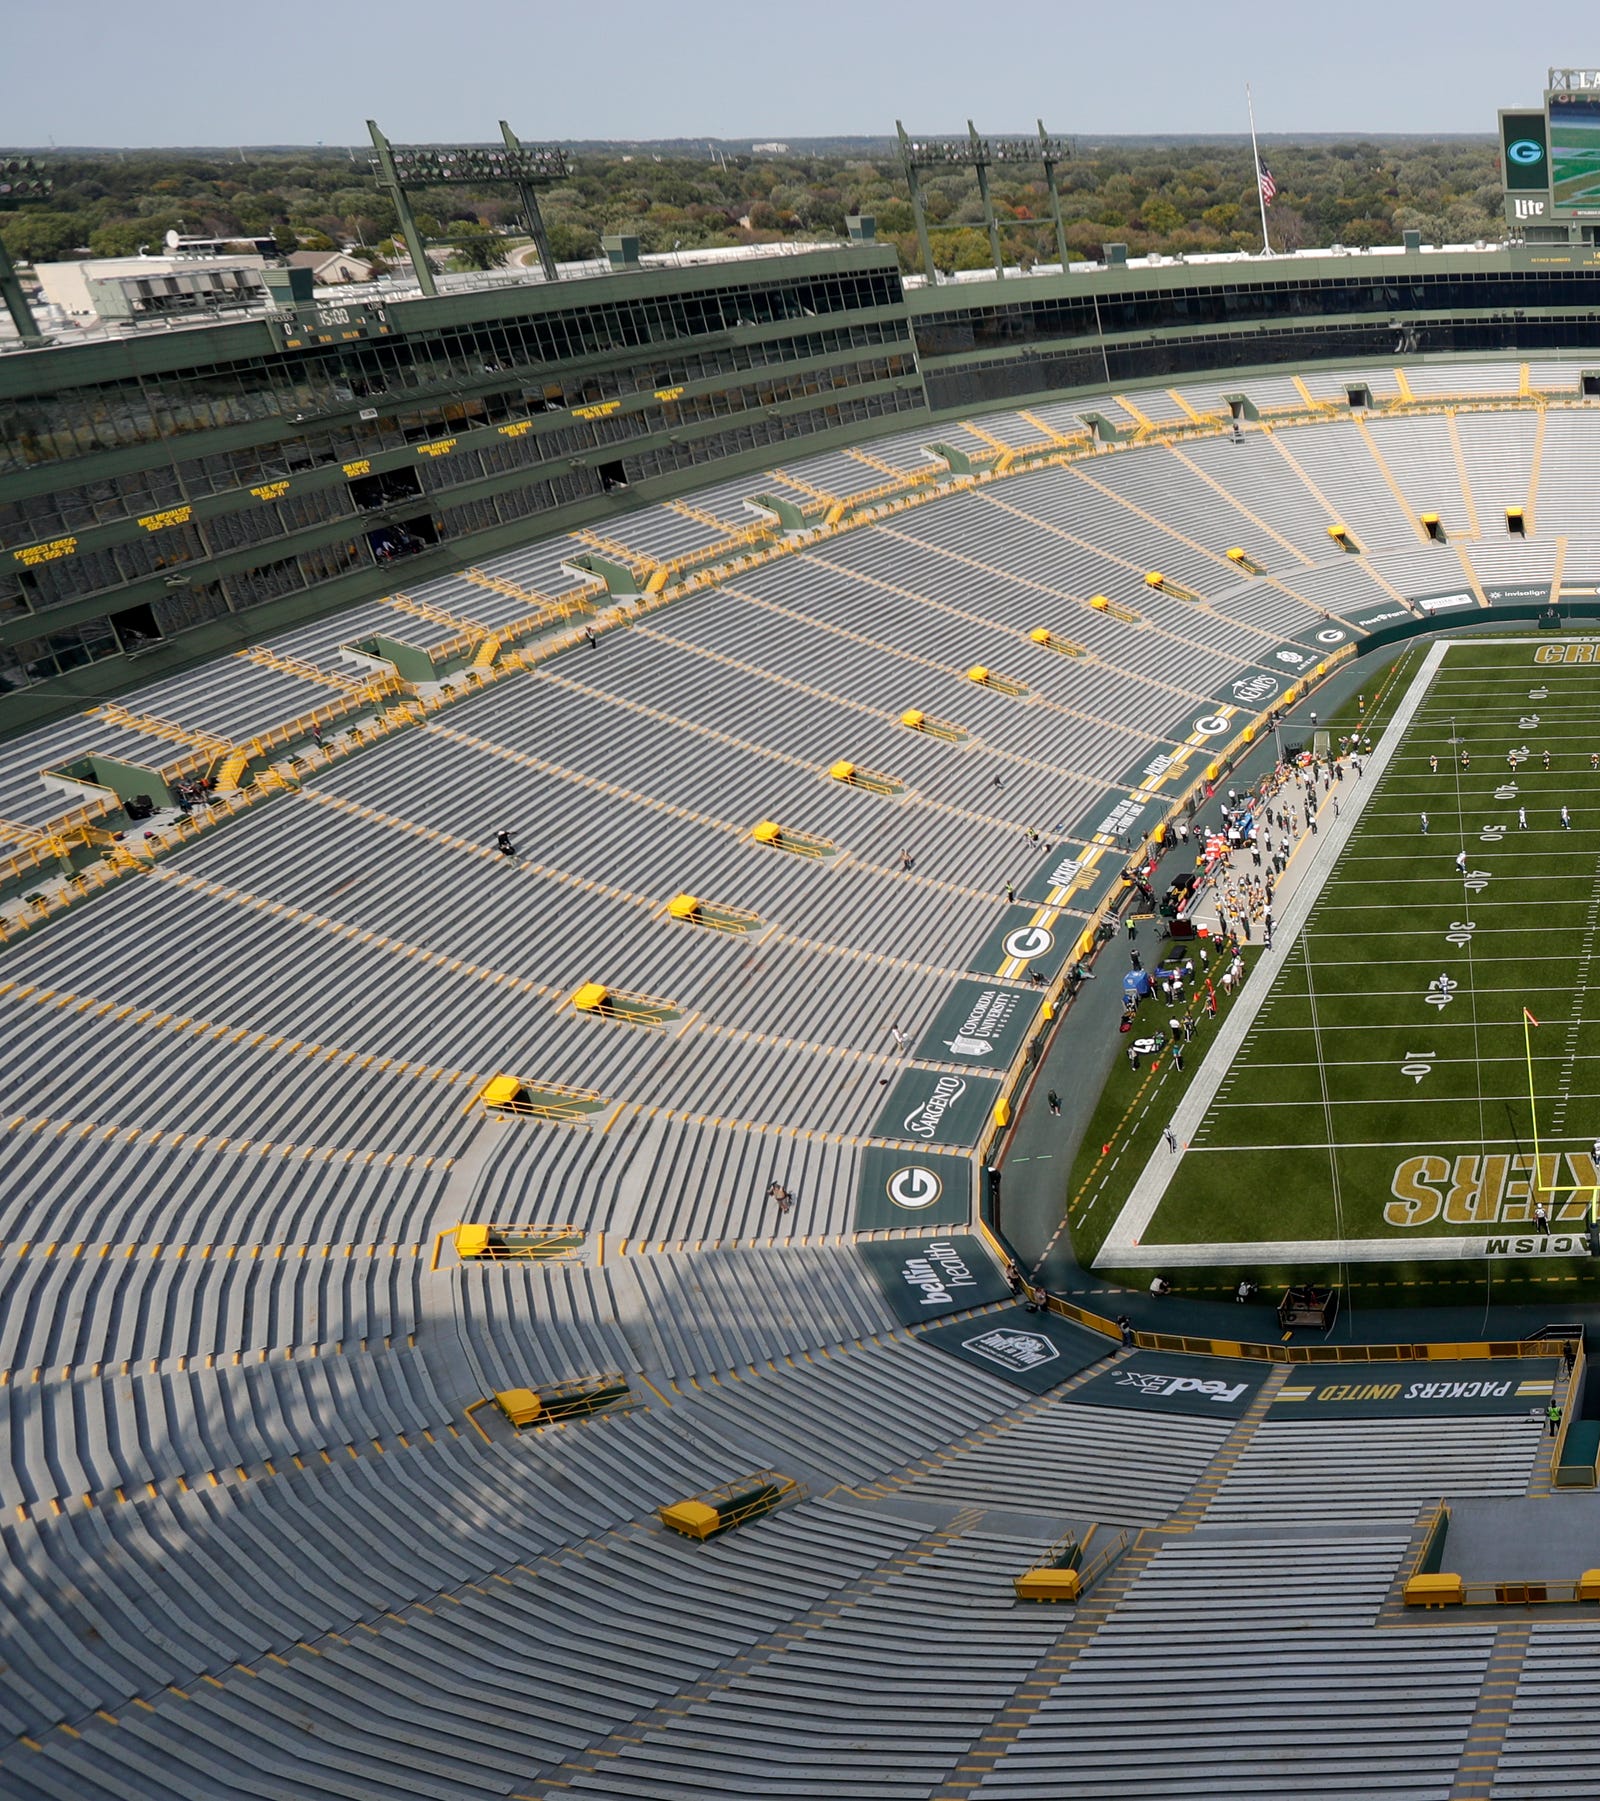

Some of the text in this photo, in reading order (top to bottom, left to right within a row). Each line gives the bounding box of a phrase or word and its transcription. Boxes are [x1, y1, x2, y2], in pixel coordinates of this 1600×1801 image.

[1507, 139, 1544, 165] G
[1514, 199, 1544, 219] Lite
[319, 308, 350, 326] 15:00
[378, 310, 386, 322] 0
[284, 322, 293, 335] 0
[137, 515, 156, 527] MIKE
[13, 537, 78, 561] FORREST GREGG
[1388, 609, 1408, 619] Farm
[1318, 630, 1344, 642] G
[1234, 674, 1277, 702] KEMPS
[1528, 687, 1550, 699] 10
[1196, 717, 1228, 733] G
[1518, 715, 1541, 729] 20
[1142, 754, 1175, 777] PACKERS
[1508, 749, 1530, 762] 30
[1494, 784, 1519, 799] 40
[1479, 824, 1507, 842] 50
[1047, 858, 1084, 888] PACKERS
[1464, 870, 1492, 889] 40
[1006, 929, 1050, 956] G
[1446, 921, 1476, 943] 30
[1425, 980, 1458, 1004] 20
[958, 990, 996, 1035] CONCORDIA
[974, 991, 1012, 1038] UNIVERSITY
[1401, 1051, 1436, 1075] 10
[910, 1076, 960, 1138] SARGENTO
[890, 1168, 938, 1207] G
[923, 1241, 978, 1287] health
[902, 1257, 953, 1305] bellin
[1116, 1372, 1249, 1402] FedEx
[1316, 1380, 1513, 1401] PACKERS UNITED
